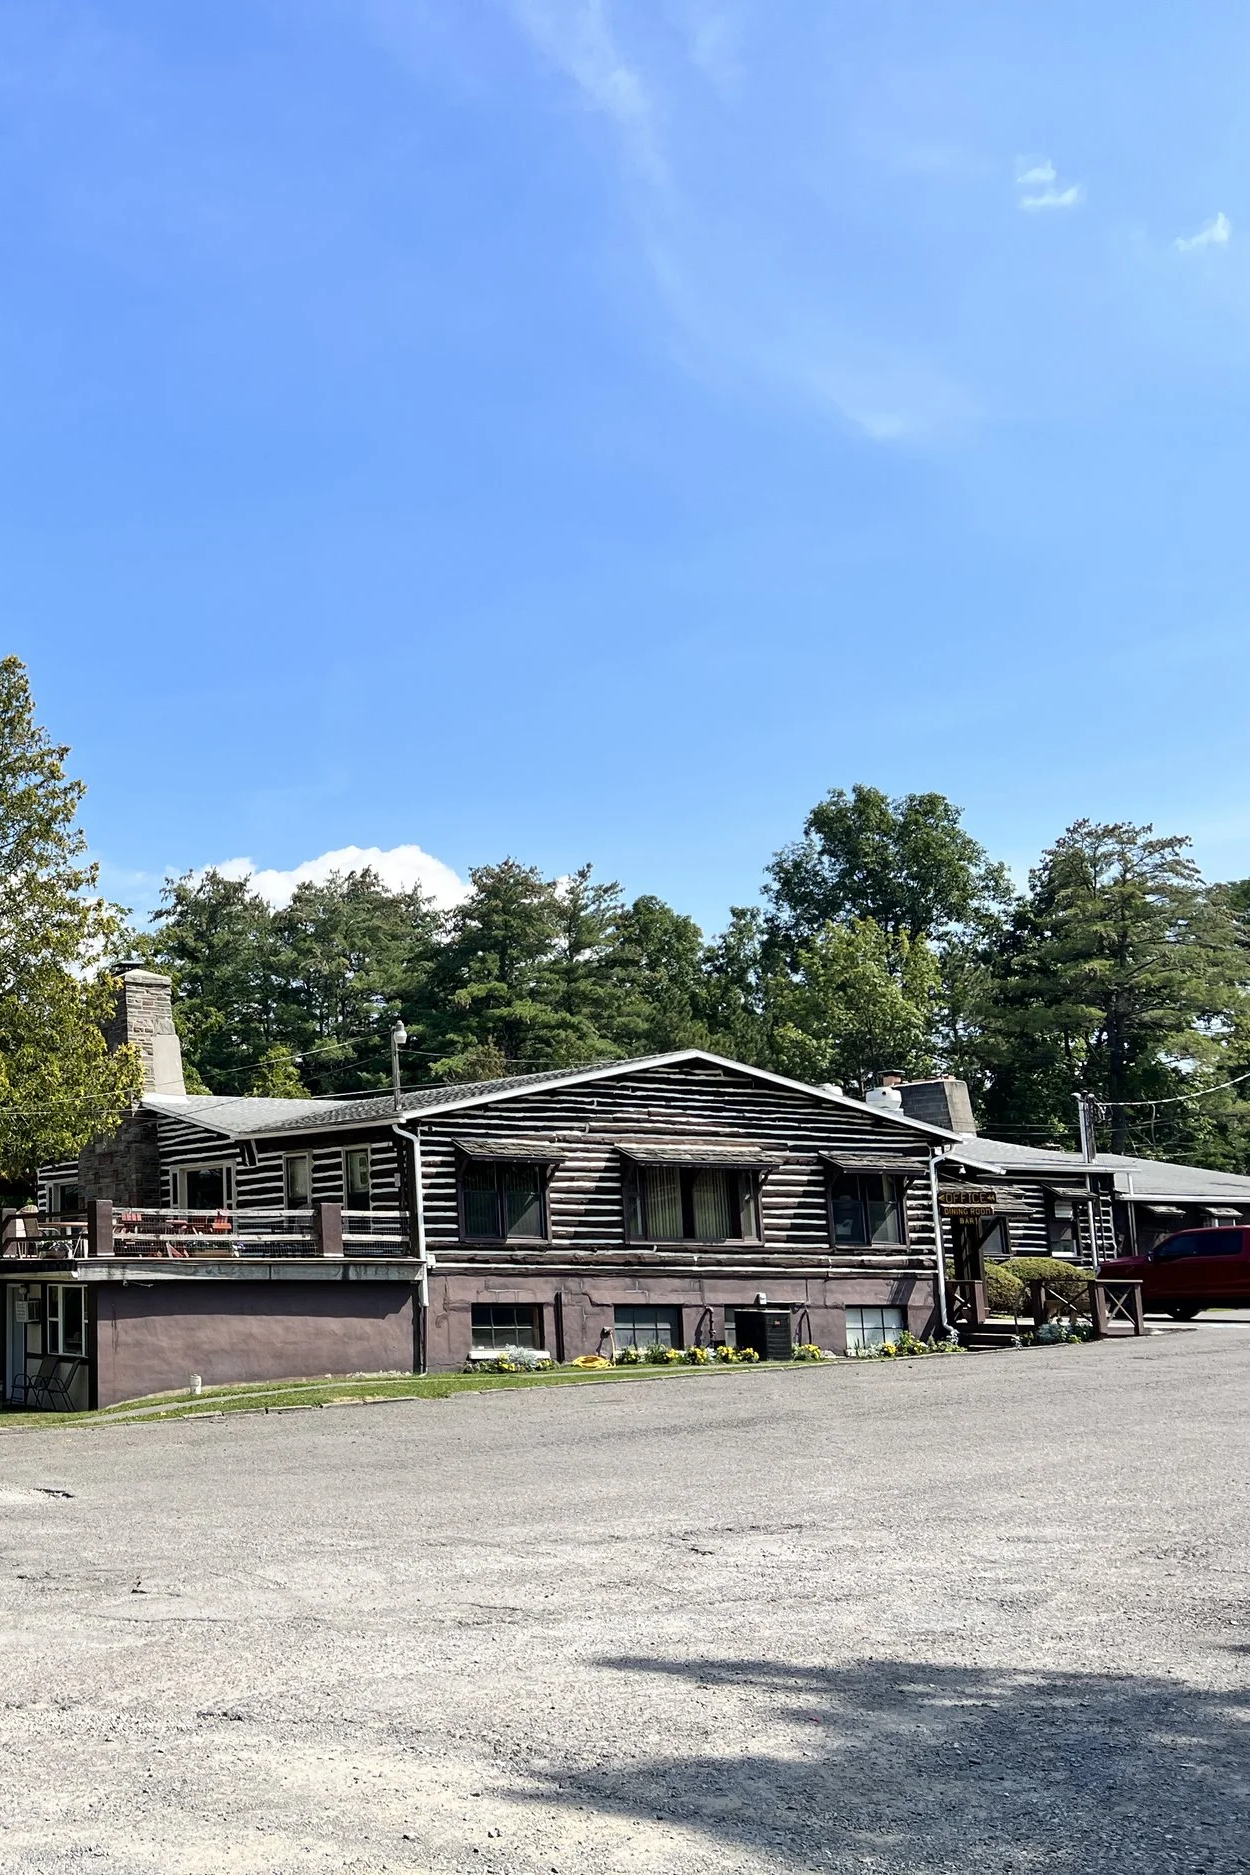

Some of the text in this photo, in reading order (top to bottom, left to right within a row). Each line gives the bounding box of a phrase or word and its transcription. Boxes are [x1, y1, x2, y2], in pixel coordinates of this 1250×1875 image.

[945, 1192, 987, 1203] OFFICE
[944, 1207, 991, 1215] DINING ROOM
[959, 1217, 975, 1225] BAR
